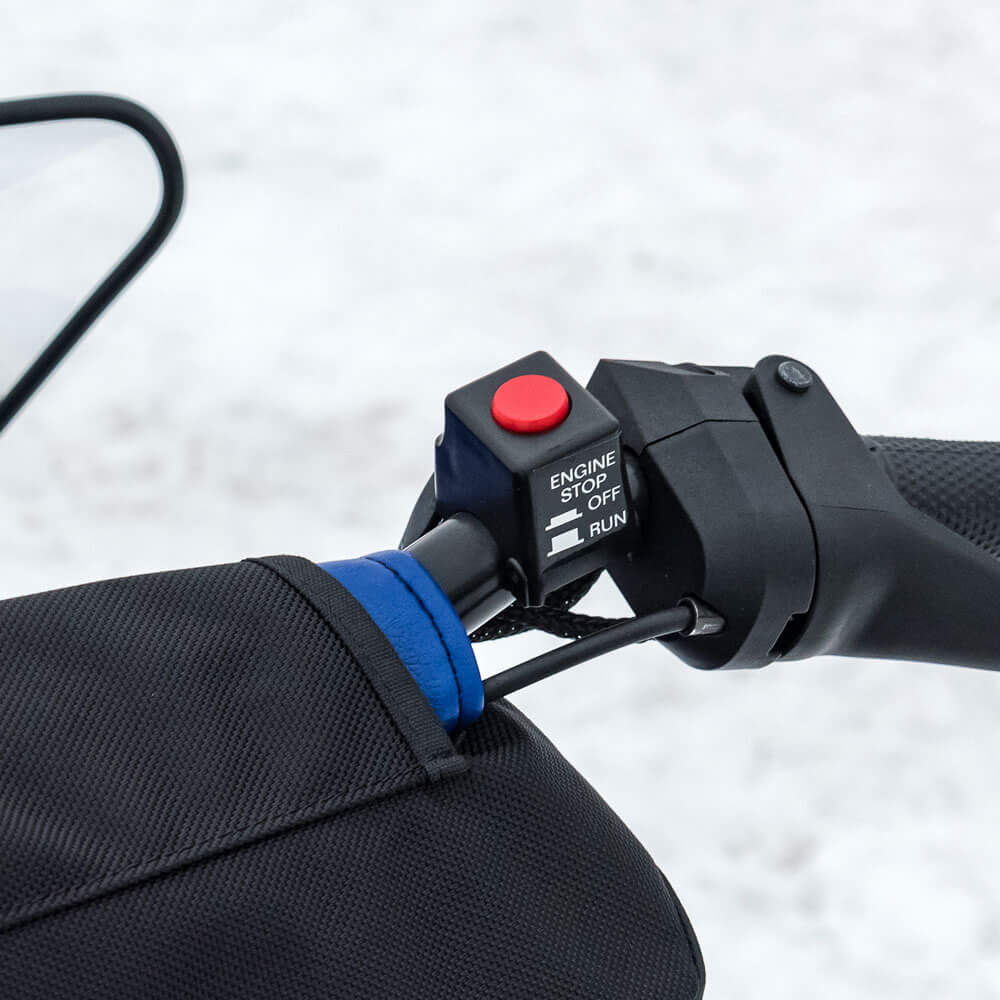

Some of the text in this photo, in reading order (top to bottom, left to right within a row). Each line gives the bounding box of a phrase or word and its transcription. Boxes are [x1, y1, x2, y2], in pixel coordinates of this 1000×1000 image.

[550, 450, 616, 490] ENGINE
[561, 472, 607, 503] STOP
[588, 485, 621, 510] OFF
[590, 510, 627, 538] RUN
